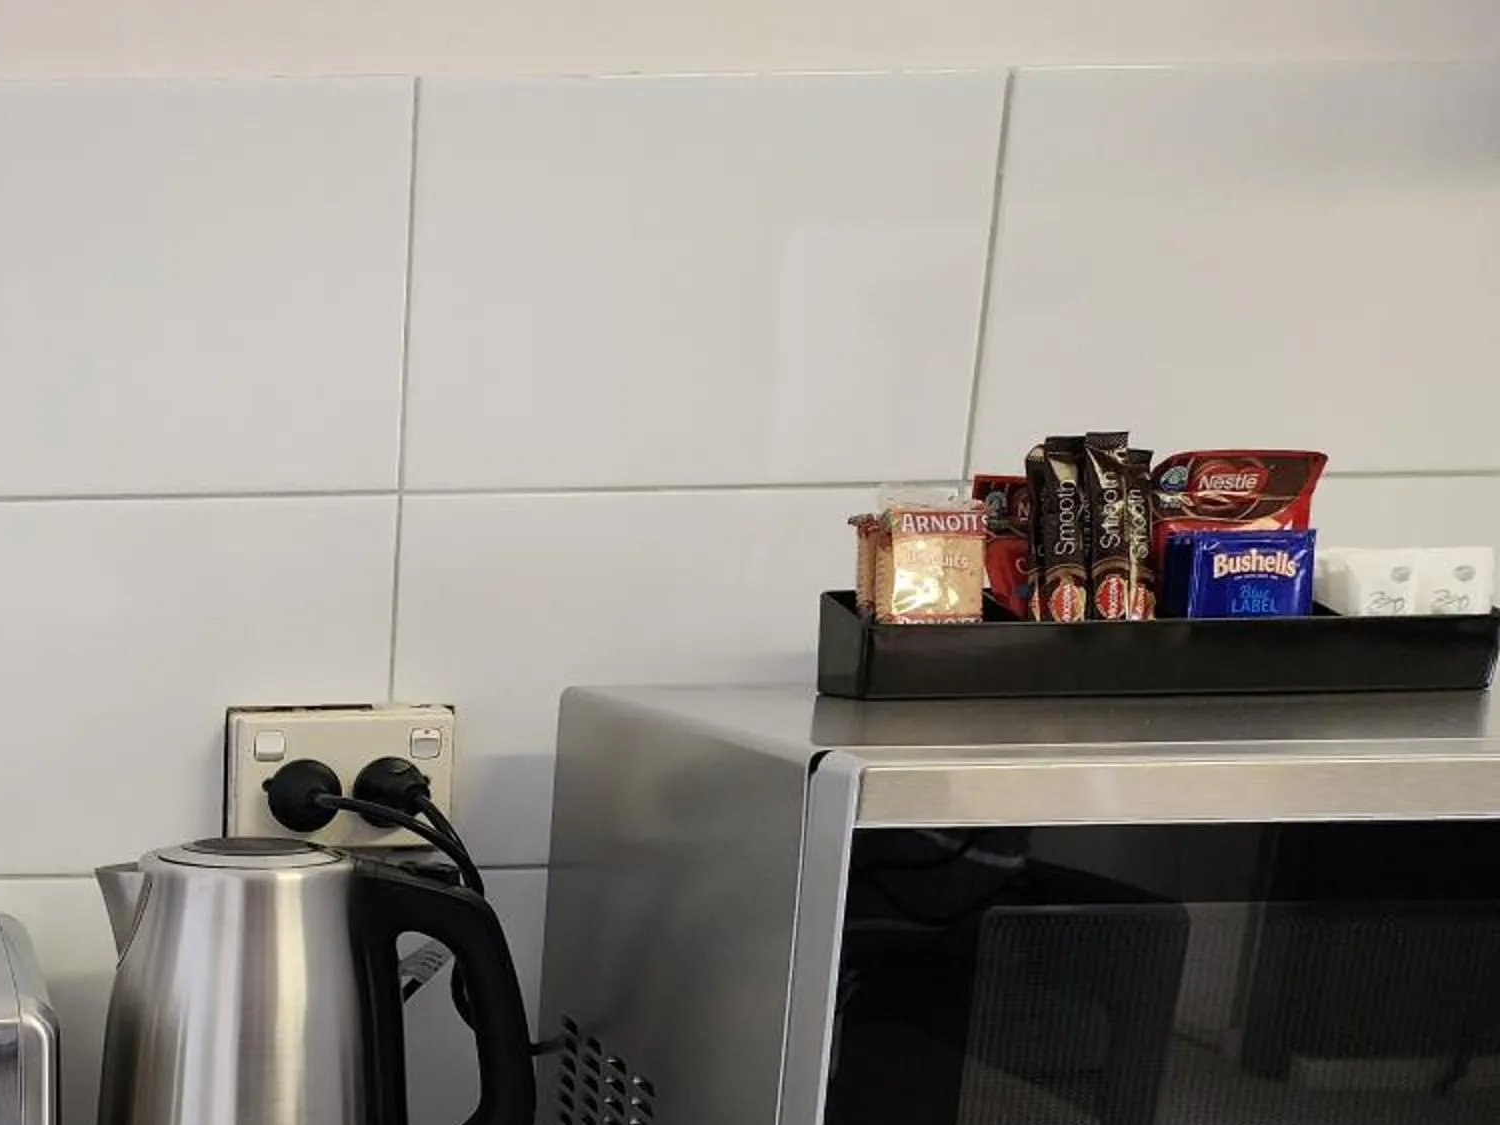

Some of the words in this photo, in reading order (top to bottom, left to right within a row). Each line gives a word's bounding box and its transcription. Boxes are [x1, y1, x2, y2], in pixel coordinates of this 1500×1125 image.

[1054, 479, 1077, 555] Smooth
[1100, 471, 1121, 549] Smooth
[1213, 548, 1298, 579] Bushells
[1231, 598, 1278, 613] LABEL
[1239, 584, 1271, 598] Blue
